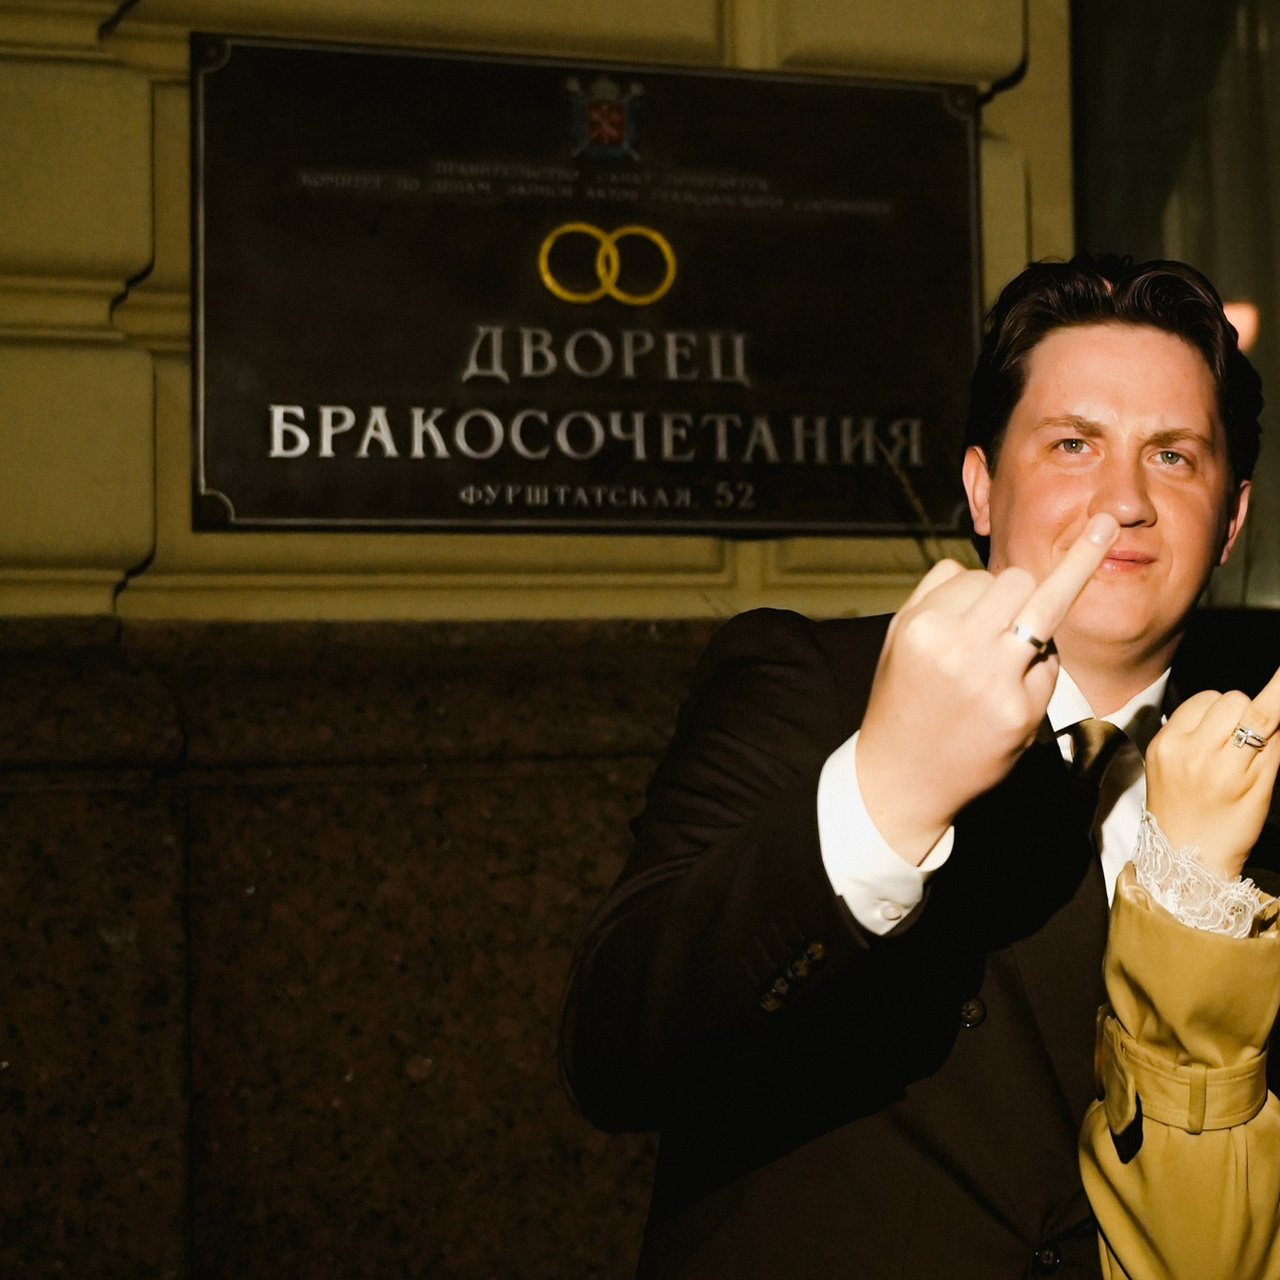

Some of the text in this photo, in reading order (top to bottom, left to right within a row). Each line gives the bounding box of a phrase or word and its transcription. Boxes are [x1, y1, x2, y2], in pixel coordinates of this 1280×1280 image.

[462, 325, 752, 390] ДВОРЕЦ
[268, 403, 925, 467] БРАКОСОЧЕТАНИЯ
[714, 480, 756, 508] 52
